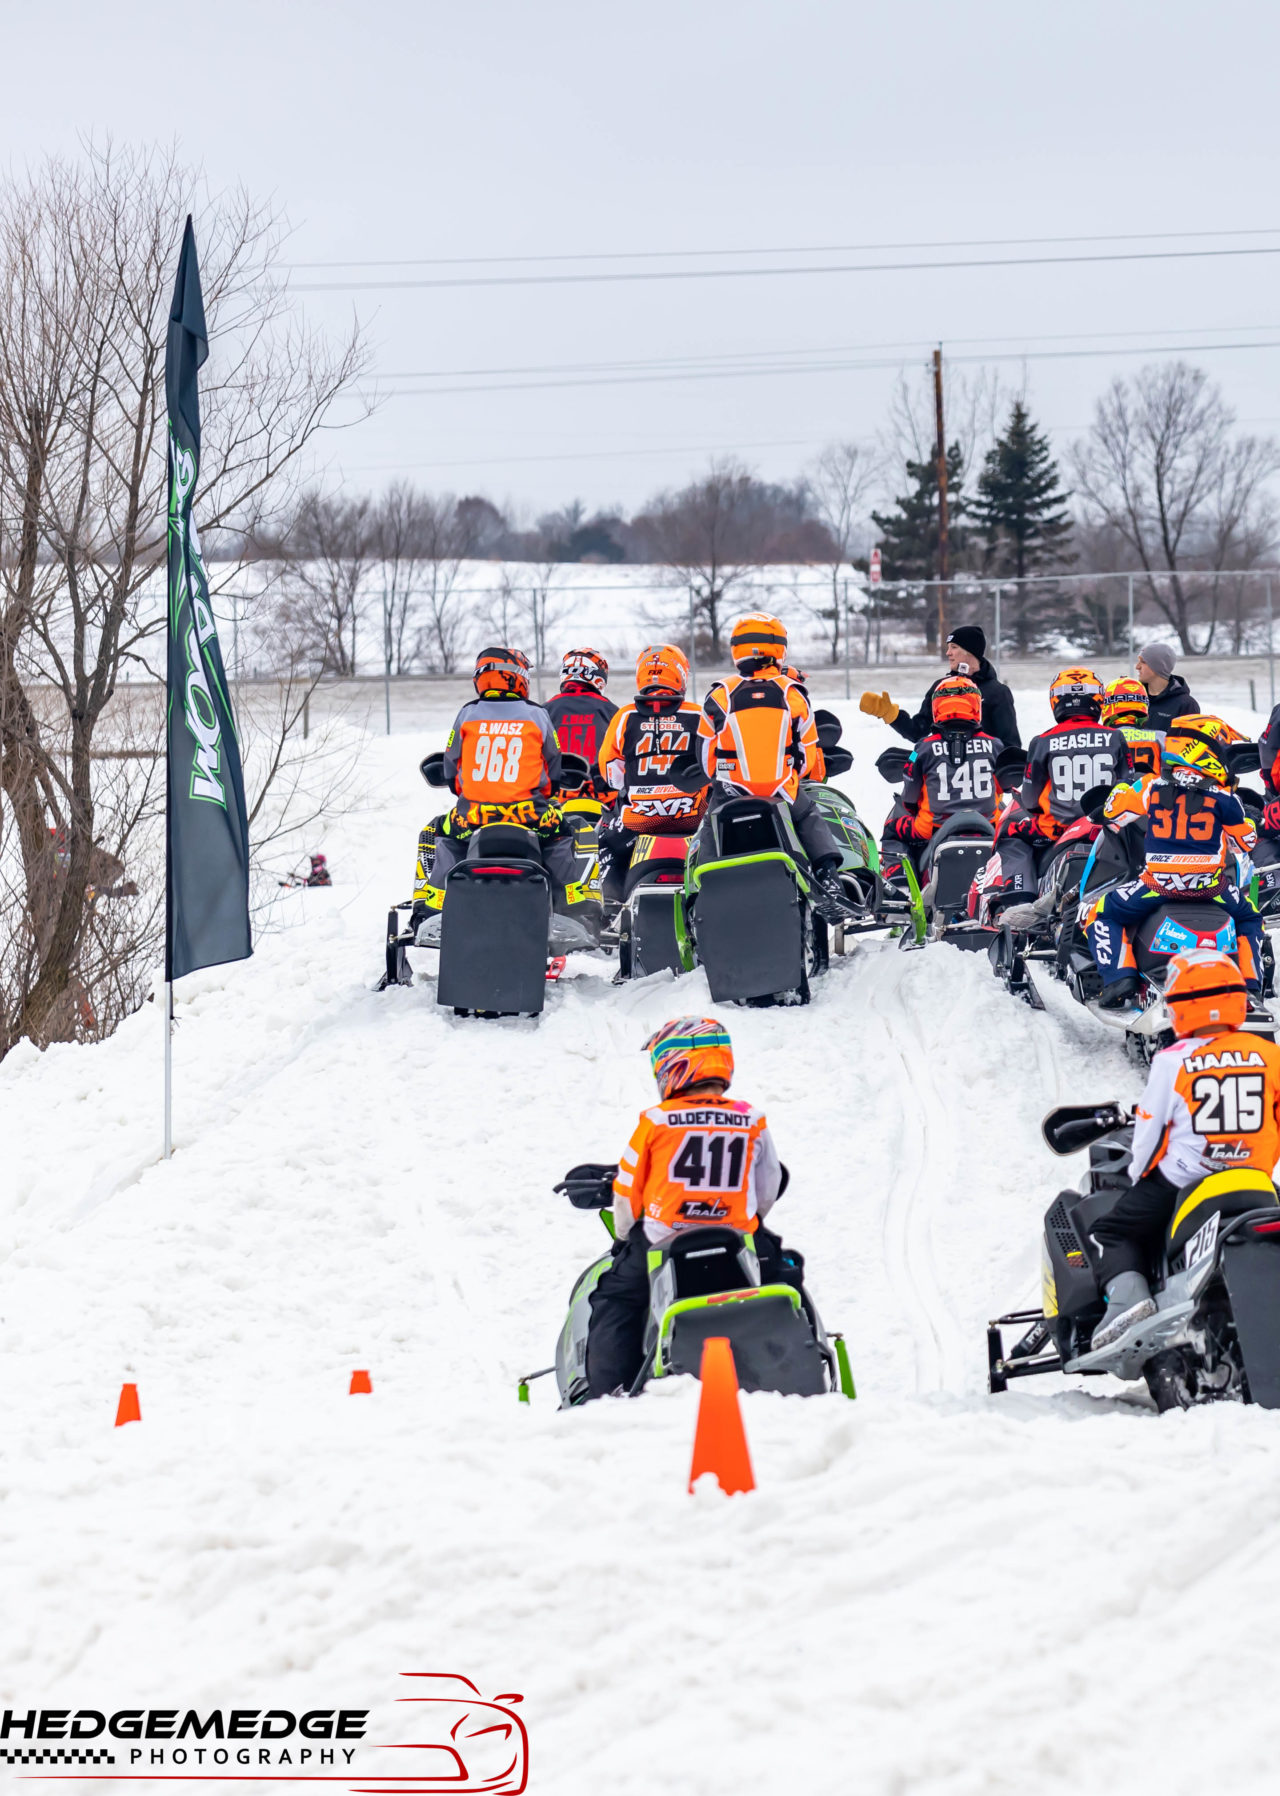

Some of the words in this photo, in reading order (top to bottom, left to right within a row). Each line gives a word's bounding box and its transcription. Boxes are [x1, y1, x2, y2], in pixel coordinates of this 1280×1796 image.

[478, 722, 524, 735] B.WASZ
[641, 722, 684, 731] STOBEL
[1050, 733, 1113, 751] BEASLEY
[472, 736, 524, 782] 968
[937, 758, 993, 800] 146
[1052, 753, 1113, 801] 996
[480, 800, 539, 824] FXR
[631, 799, 694, 817] FXR
[1151, 791, 1216, 841] 315
[1149, 854, 1172, 863] RACE
[1171, 855, 1214, 863] DIVISION
[1015, 874, 1023, 890] FXR
[1152, 872, 1214, 891] FXR
[1094, 920, 1112, 965] FXR
[1184, 1051, 1266, 1073] HAALA
[1193, 1074, 1264, 1134] 215
[673, 1135, 746, 1188] 411
[1189, 1216, 1217, 1267] 215
